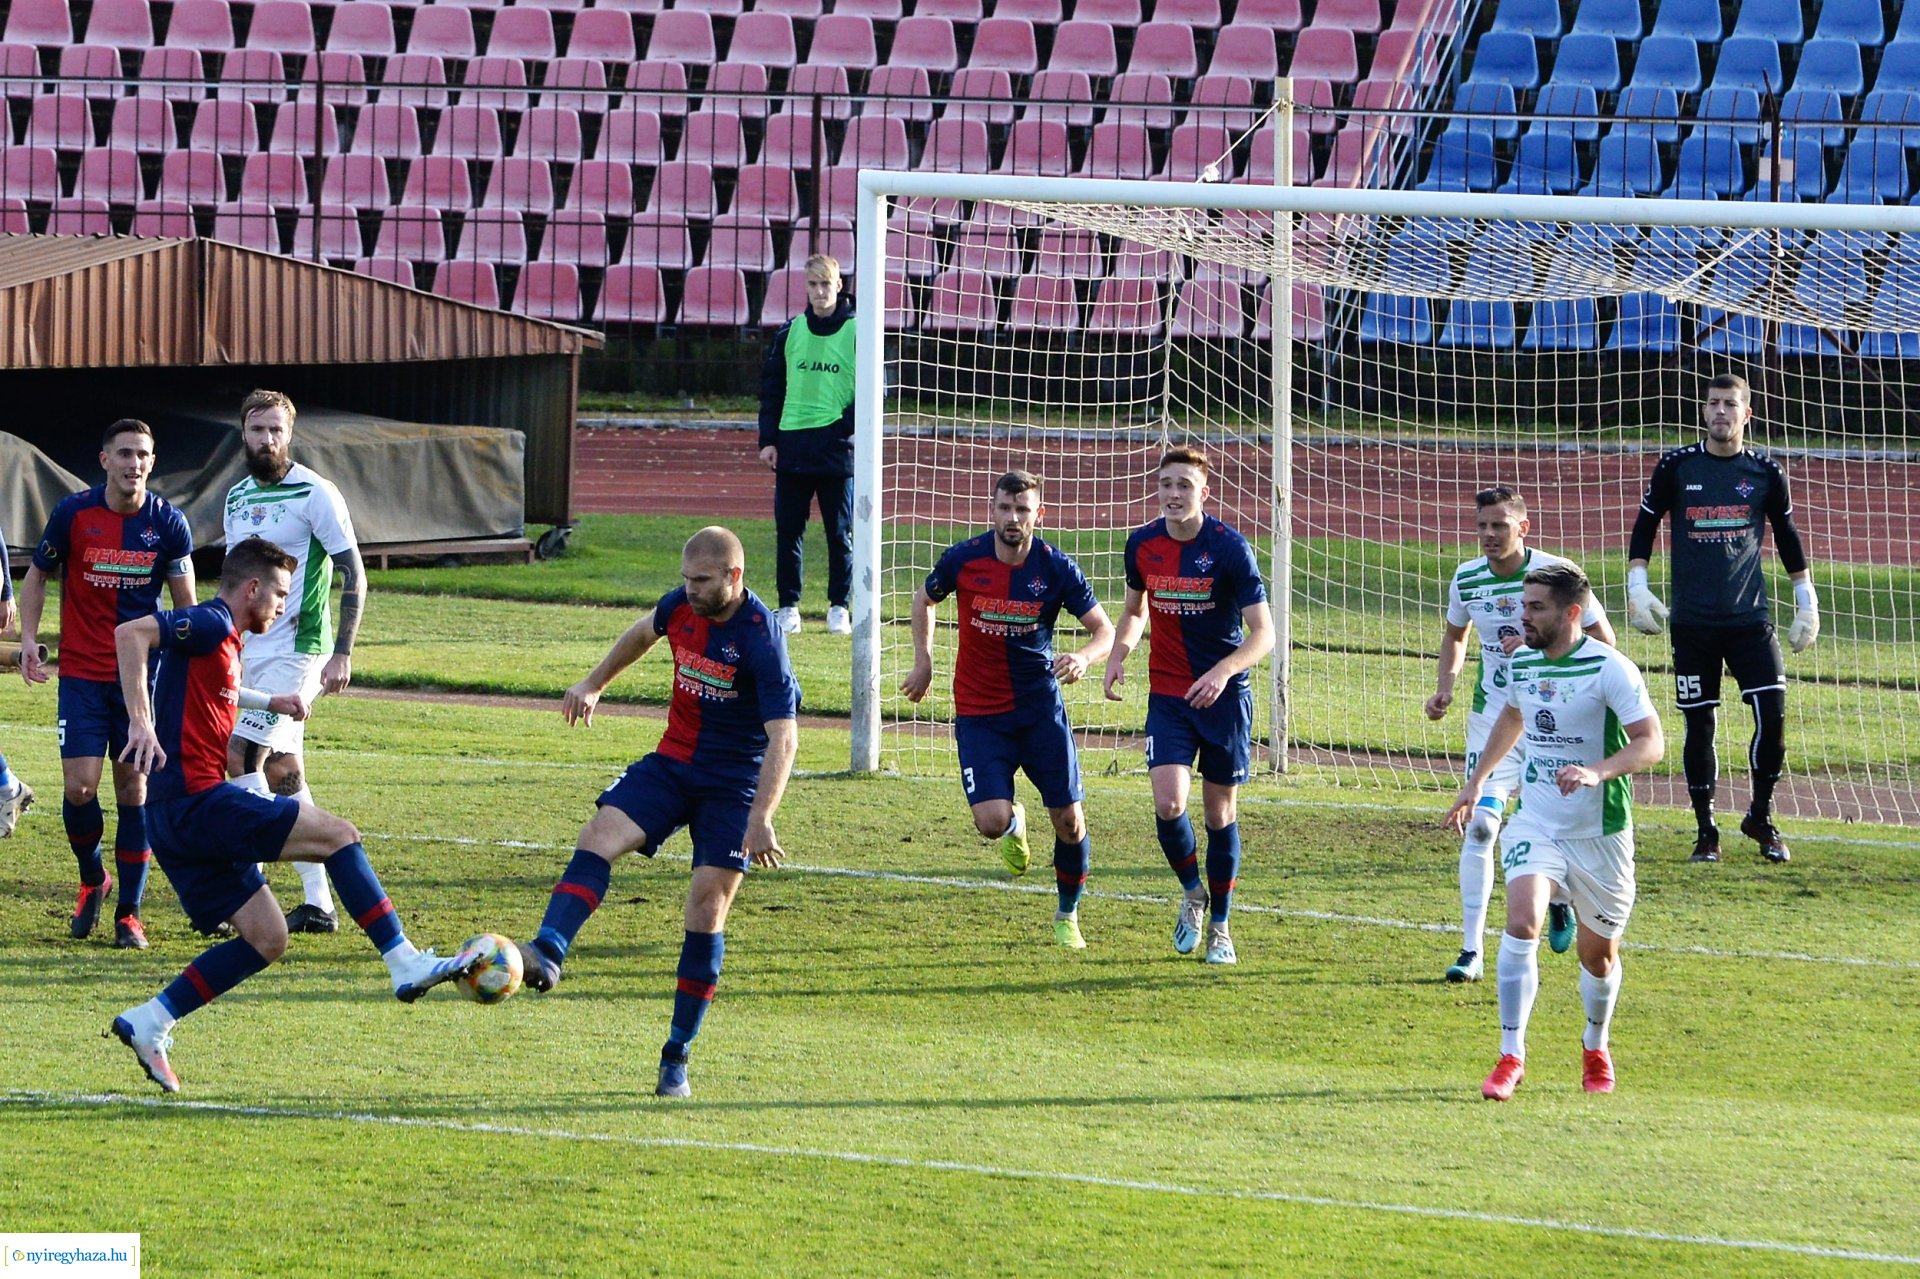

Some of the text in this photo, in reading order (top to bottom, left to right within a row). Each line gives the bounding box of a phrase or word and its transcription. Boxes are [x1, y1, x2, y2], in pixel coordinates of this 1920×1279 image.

[811, 361, 840, 374] JAKO
[83, 547, 158, 567] REVESZ
[1146, 574, 1214, 592] REVESZ
[971, 595, 1043, 616] REVESZ
[676, 645, 738, 682] REVESZ
[1677, 675, 1702, 699] 95
[1503, 840, 1531, 872] 92
